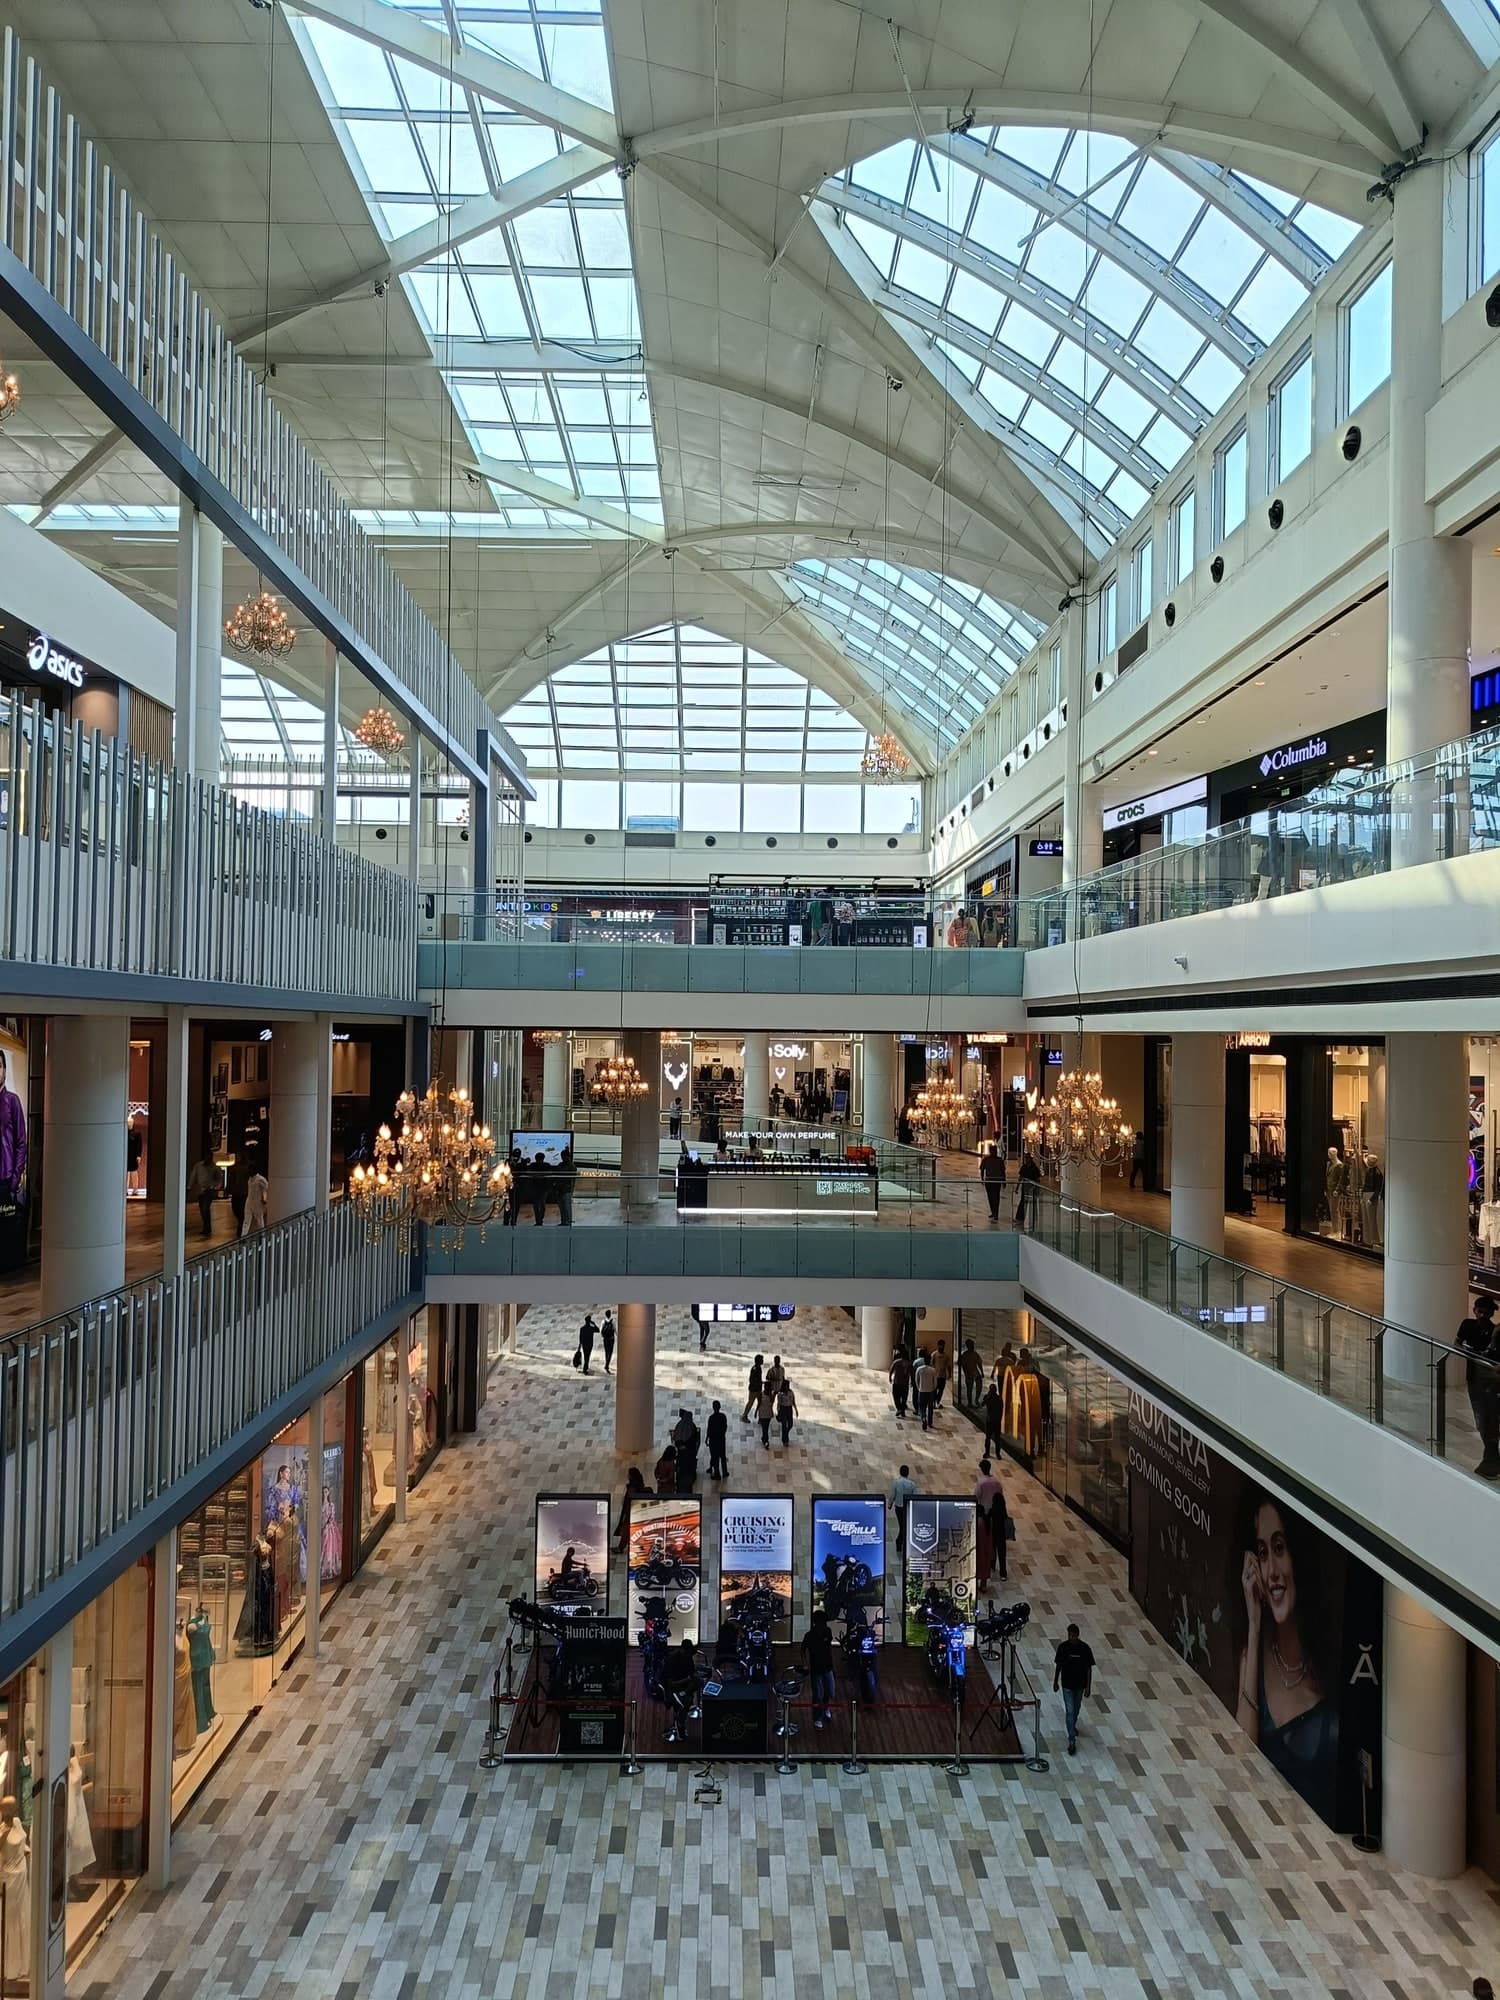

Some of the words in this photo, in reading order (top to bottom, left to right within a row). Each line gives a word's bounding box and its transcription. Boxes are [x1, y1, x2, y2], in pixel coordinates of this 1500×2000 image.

[47, 649, 83, 688] asics
[1271, 737, 1327, 770] Columbia
[1117, 803, 1145, 822] crocs
[496, 902, 531, 911] UNTD
[533, 902, 559, 912] KIDS
[606, 910, 655, 922] LIBERTY
[1239, 1031, 1271, 1047] ARROW
[774, 1044, 806, 1060] Solly
[725, 1131, 749, 1139] MAKE
[797, 1132, 836, 1140] PERFUME
[1128, 1446, 1173, 1502] COMING
[1174, 1487, 1211, 1537] SOON
[724, 1516, 785, 1527] CRUISING
[724, 1534, 776, 1545] PUREST
